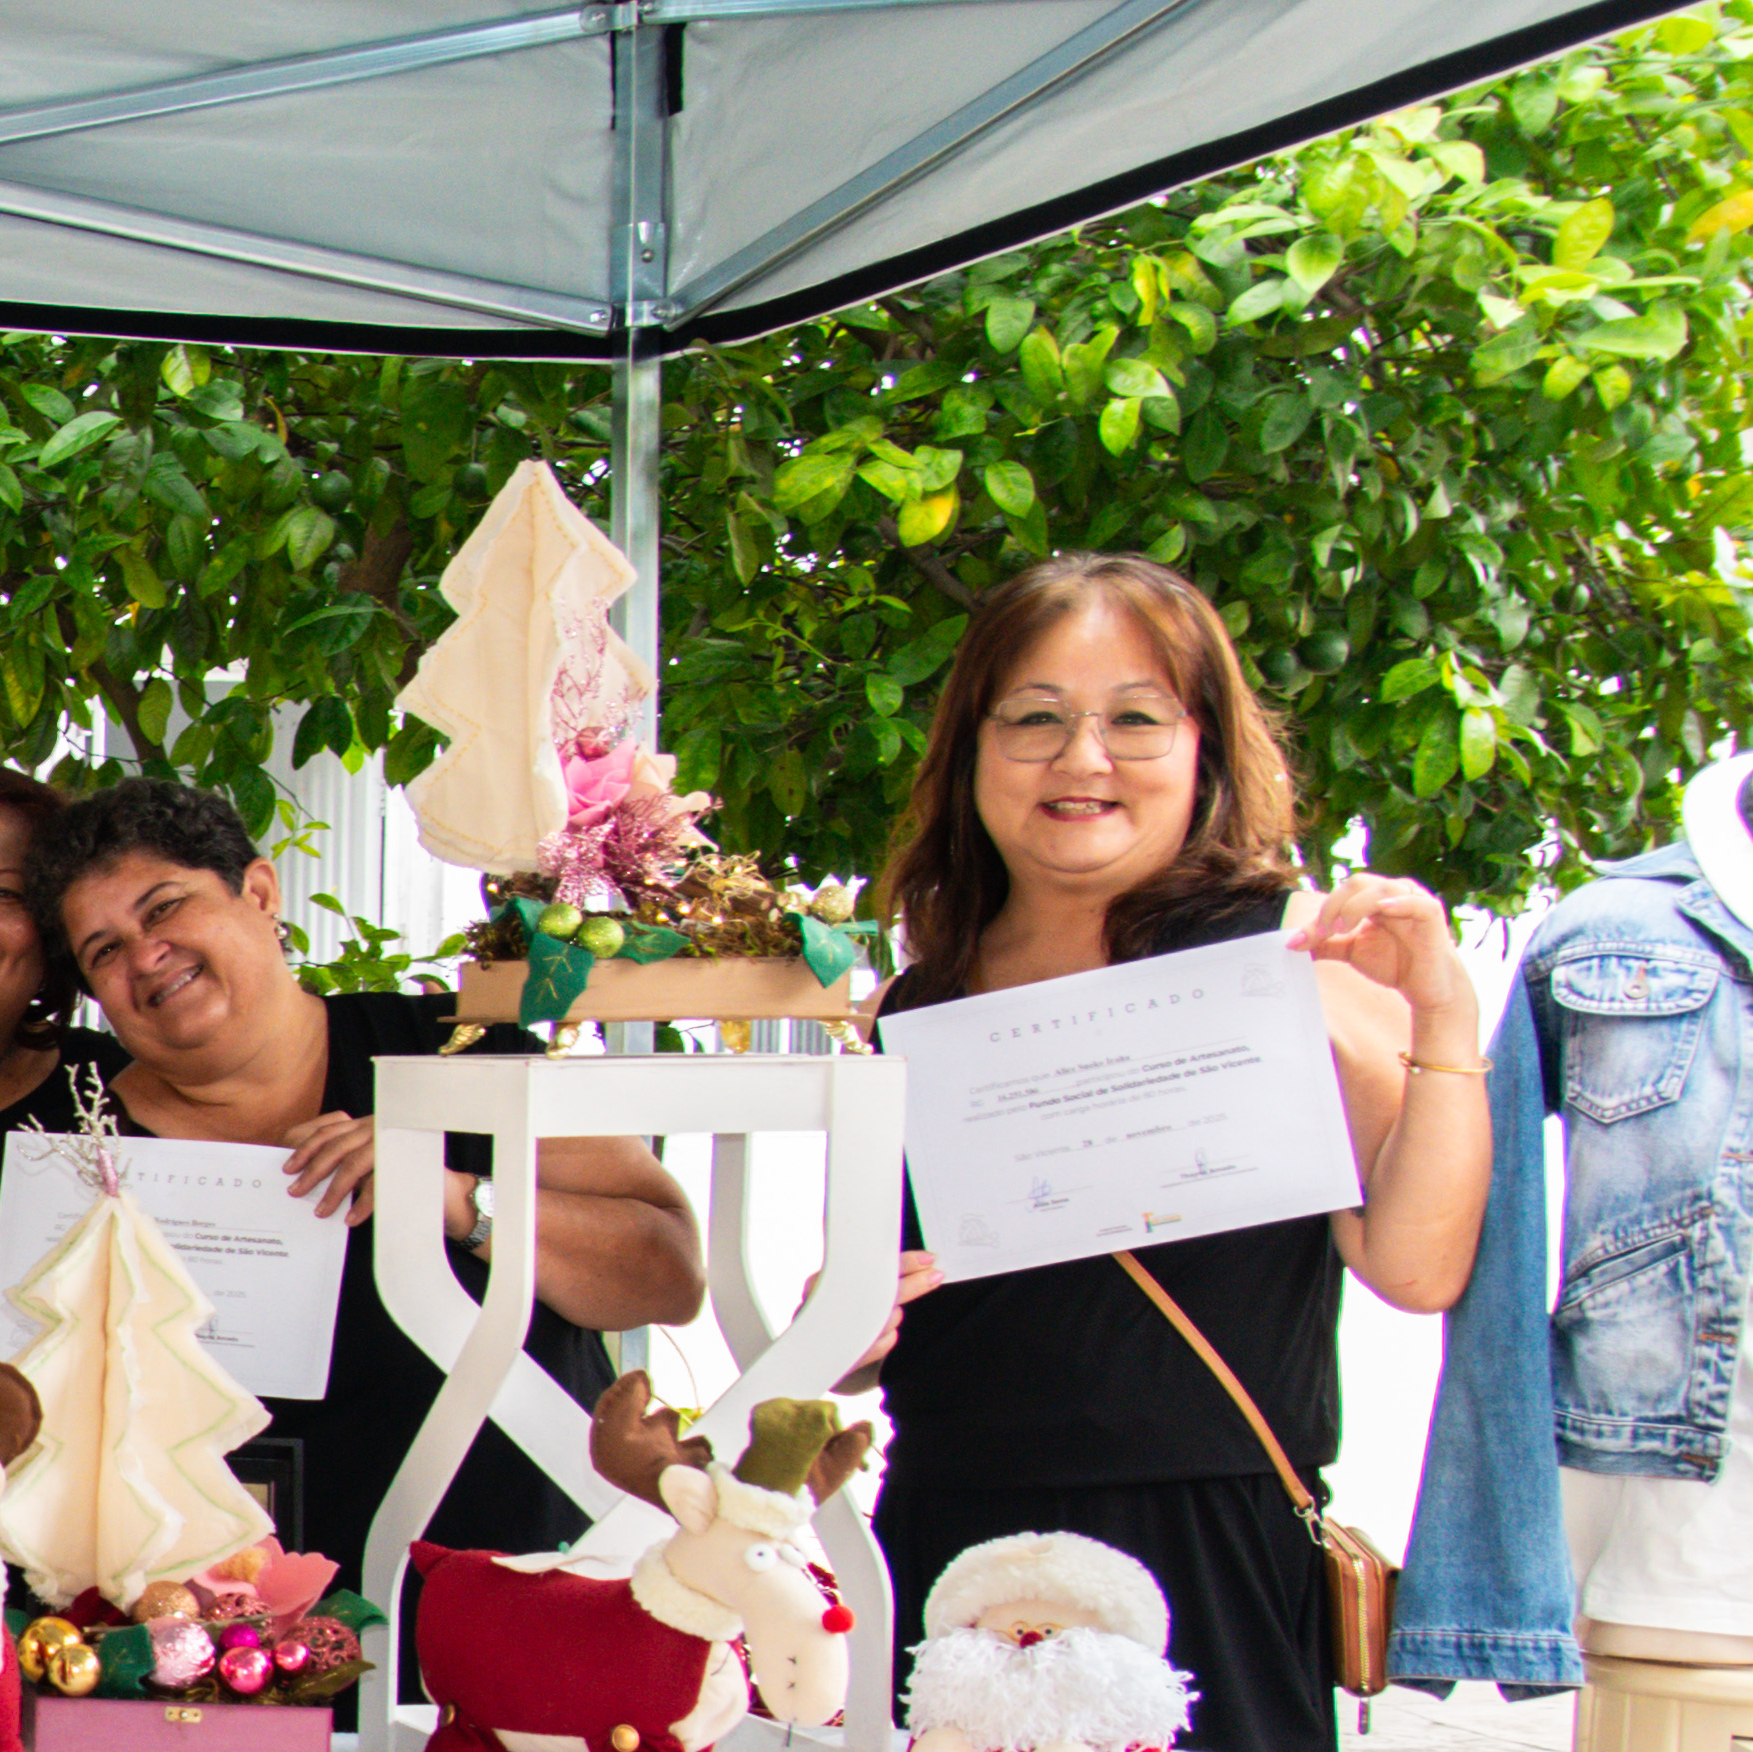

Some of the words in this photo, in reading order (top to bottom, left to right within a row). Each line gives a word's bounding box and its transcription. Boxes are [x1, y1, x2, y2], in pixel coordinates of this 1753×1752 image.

[989, 989, 1205, 1043] CERTIFICADO
[1028, 1096, 1061, 1110] Fundo
[1062, 1089, 1094, 1103] Social
[1095, 1086, 1108, 1097] de
[1110, 1071, 1182, 1094] Solidariedade
[1182, 1068, 1198, 1079] de
[1199, 1063, 1220, 1076] São
[137, 1172, 262, 1188] TIFICADO
[171, 1243, 223, 1253] lidariedade
